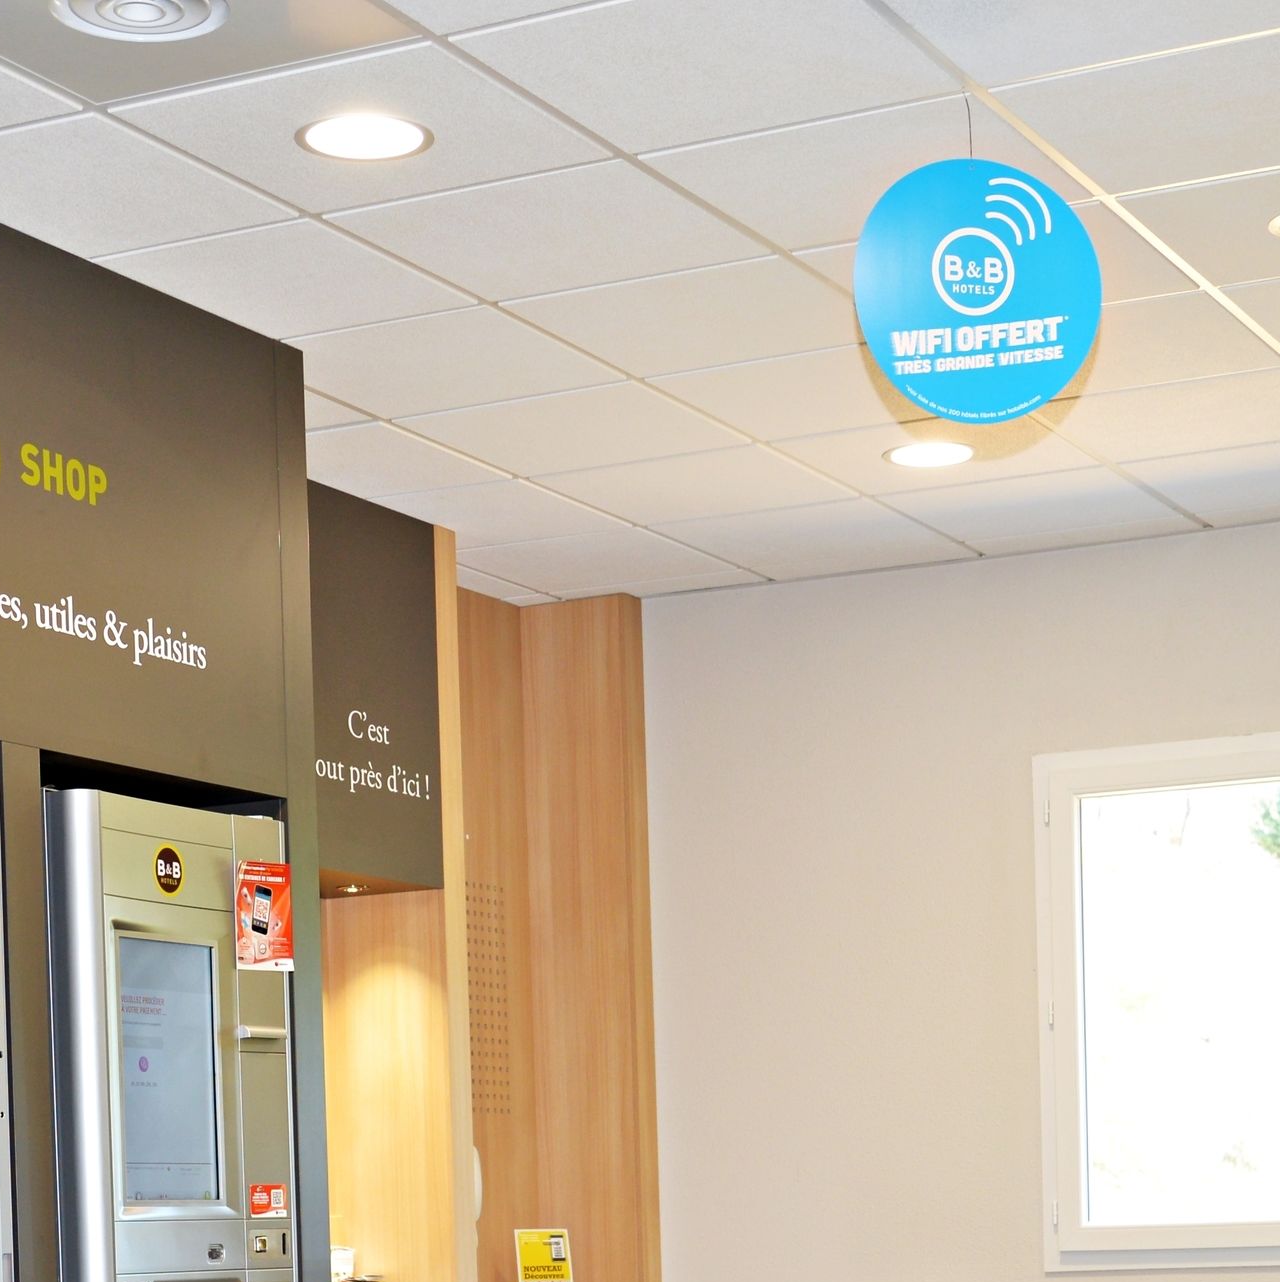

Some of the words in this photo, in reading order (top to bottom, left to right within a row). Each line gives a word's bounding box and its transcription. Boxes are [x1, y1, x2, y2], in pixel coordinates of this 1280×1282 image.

[943, 253, 1005, 285] B&B
[952, 284, 995, 296] HOTELS
[890, 327, 953, 357] WIFI
[893, 356, 932, 376] TRÈS
[936, 352, 996, 373] GRANDE
[998, 345, 1065, 367] VITESSE
[20, 442, 108, 506] SHOP
[34, 595, 97, 641] utiles
[103, 609, 129, 649] &
[132, 617, 207, 670] plaisirs
[347, 709, 390, 745] C'est
[315, 758, 345, 781] out
[349, 760, 383, 793] près
[157, 858, 181, 879] B&B
[523, 1265, 563, 1273] NOUVEAU
